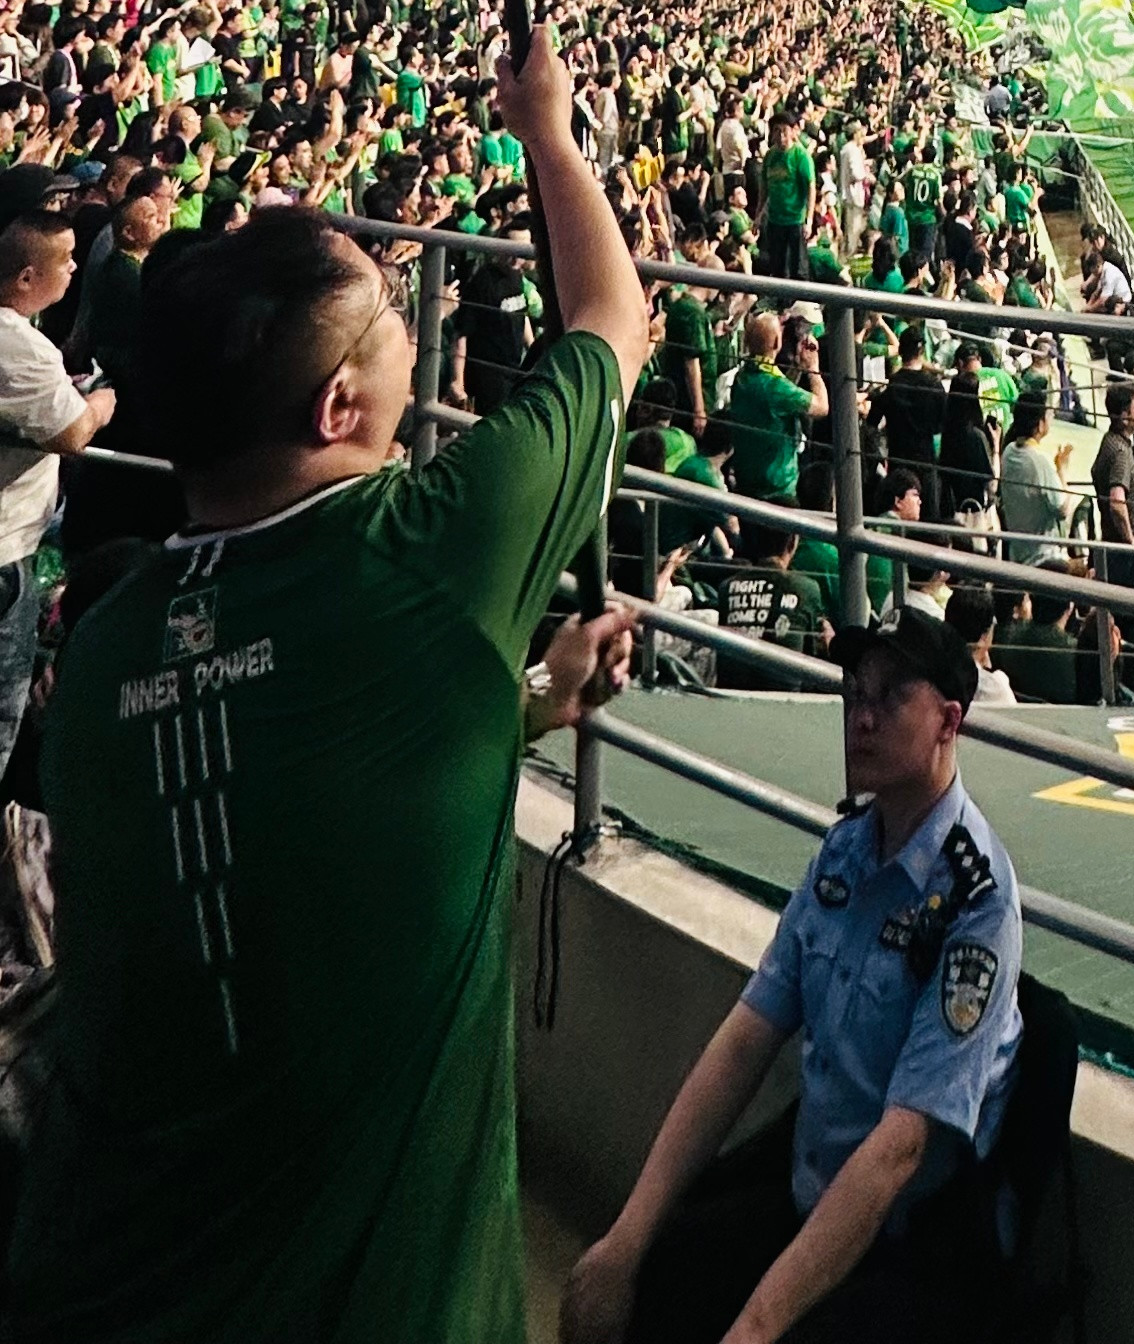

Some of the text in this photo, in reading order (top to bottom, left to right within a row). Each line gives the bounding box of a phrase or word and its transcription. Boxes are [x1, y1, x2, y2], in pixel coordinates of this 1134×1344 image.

[729, 580, 767, 594] FIGHT
[728, 594, 749, 611] TILL
[750, 593, 773, 608] THE
[727, 610, 757, 625] COME
[119, 637, 275, 720] INNER POWER
